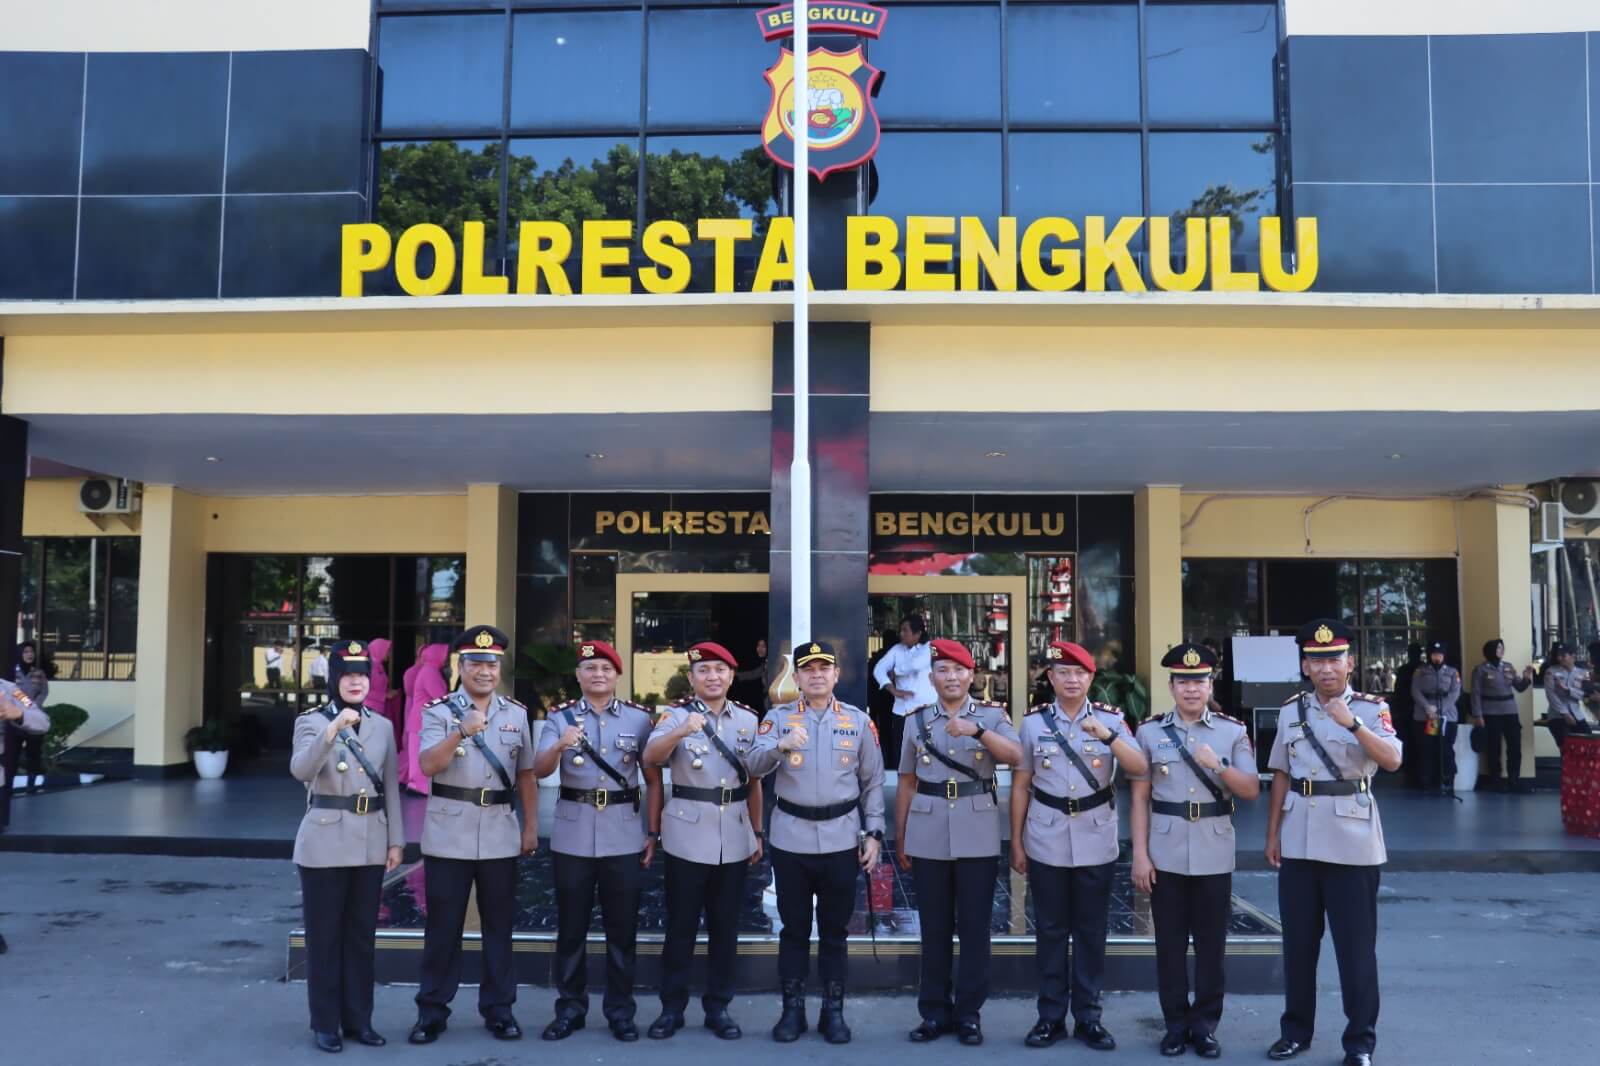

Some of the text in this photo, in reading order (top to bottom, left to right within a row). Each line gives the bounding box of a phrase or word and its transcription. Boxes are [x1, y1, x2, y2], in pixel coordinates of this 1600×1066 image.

[768, 8, 875, 27] BEGKULU
[341, 216, 1319, 297] POLRESTA BENGKULU
[595, 511, 1065, 536] POLRESTA BENGKULU
[833, 729, 858, 737] POLRI
